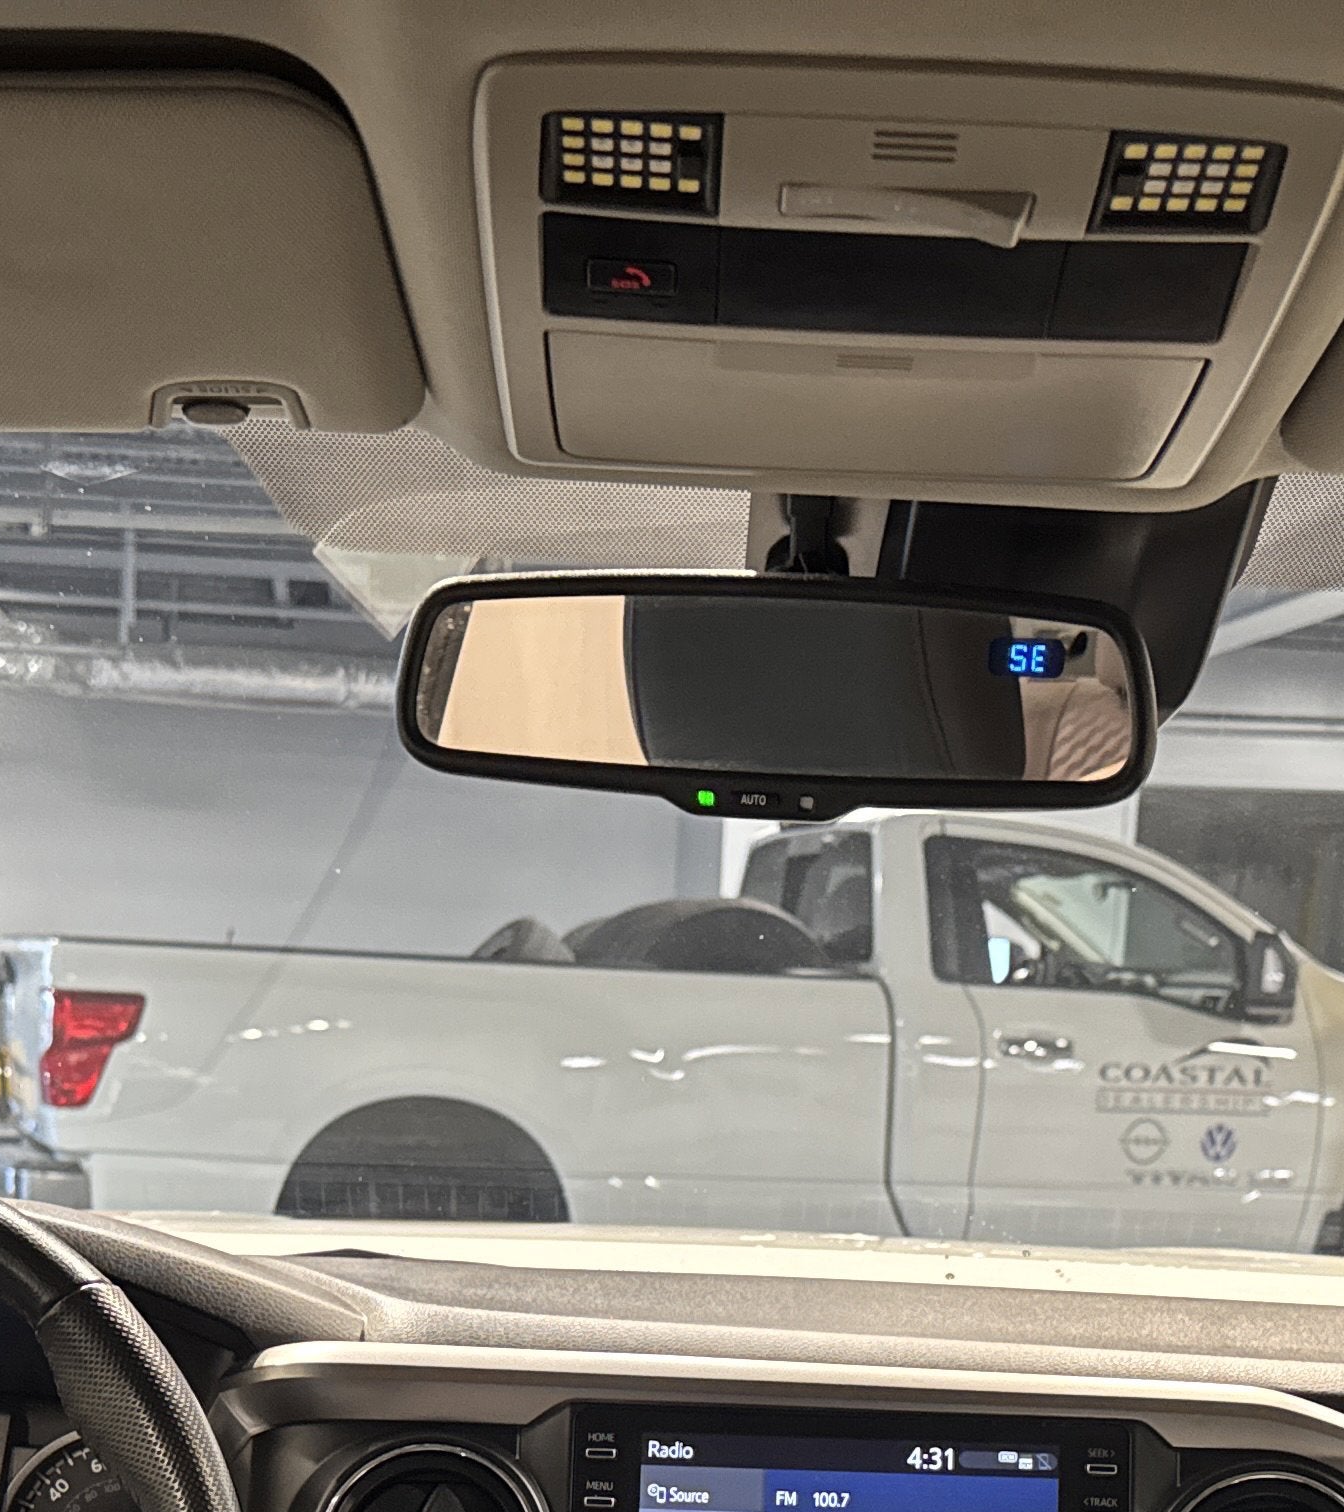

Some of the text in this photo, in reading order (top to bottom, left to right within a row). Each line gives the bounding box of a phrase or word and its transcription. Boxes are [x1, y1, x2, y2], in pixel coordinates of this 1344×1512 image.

[1009, 644, 1046, 672] SE
[741, 794, 766, 806] AUTO
[1099, 1062, 1270, 1088] COASTAL
[588, 1432, 616, 1442] HOME
[647, 1440, 695, 1459] Radio
[1087, 1448, 1109, 1458] SEEK
[906, 1446, 955, 1471] 4:31
[49, 1478, 70, 1502] 40
[586, 1481, 614, 1491] MENU
[669, 1487, 710, 1504] Source
[775, 1491, 850, 1508] FM 100.7
[1090, 1498, 1118, 1507] TRACK
